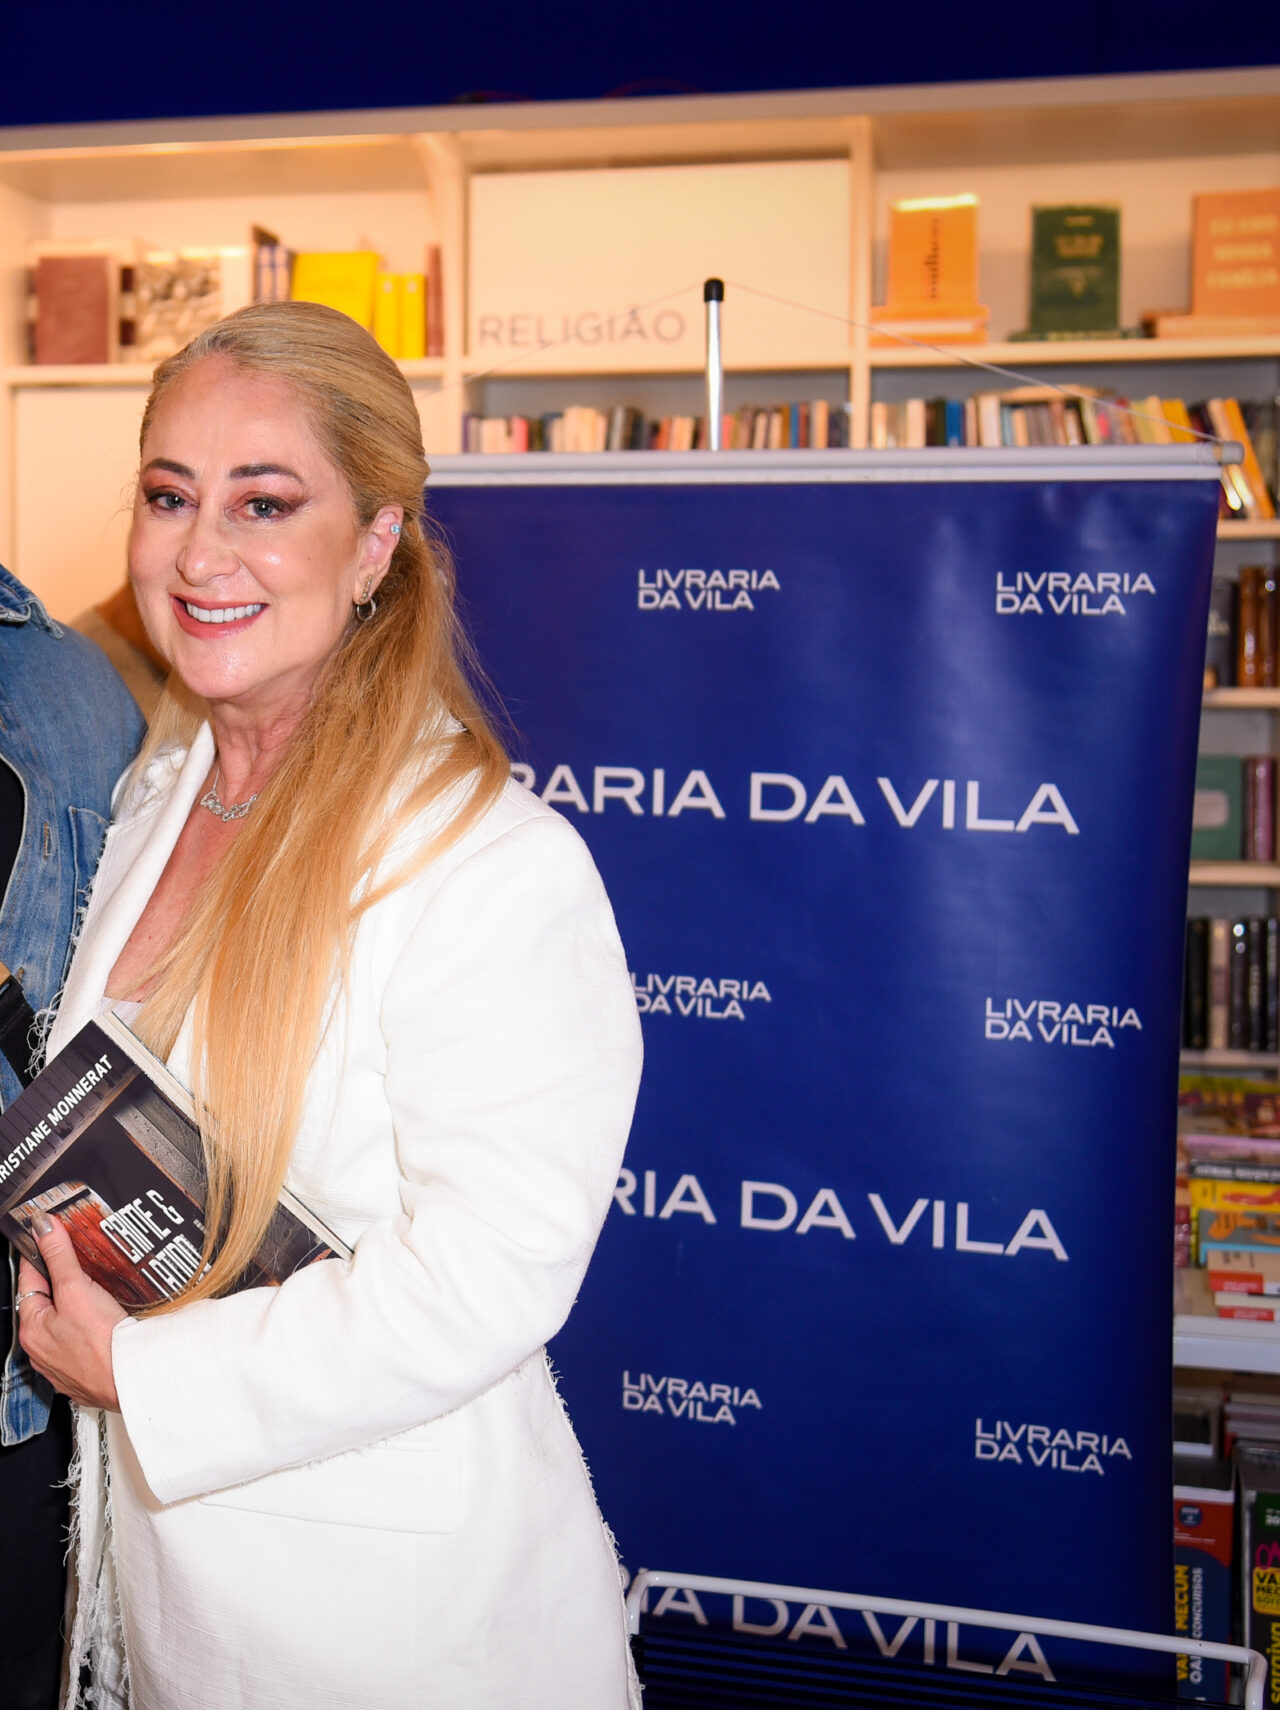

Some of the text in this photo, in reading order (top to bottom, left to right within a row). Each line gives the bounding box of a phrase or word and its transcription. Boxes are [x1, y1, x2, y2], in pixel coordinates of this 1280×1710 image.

[478, 304, 686, 346] RELIGIÃO
[638, 569, 781, 591] LIVRARIA
[996, 571, 1156, 595] LIVRARIA
[638, 589, 754, 611] DA VILA
[995, 592, 1126, 616] DA VILA
[750, 772, 866, 825] DA
[877, 777, 1080, 835] VILA
[630, 972, 772, 1003] LIVRARIA
[635, 993, 745, 1021] DA VILA
[985, 997, 1142, 1030] LIVRARIA
[985, 1018, 1115, 1048] DA VILA
[47, 1054, 113, 1127] MONNERAT
[740, 1180, 856, 1240] DA
[868, 1193, 1070, 1262] VILA
[623, 1370, 763, 1410] LIVRARIA
[623, 1389, 737, 1426] DA VILA
[975, 1438, 1105, 1476] DA VILA
[976, 1418, 1133, 1461] LIVRARIA
[732, 1594, 847, 1649] DA
[861, 1610, 1057, 1682] VILA
